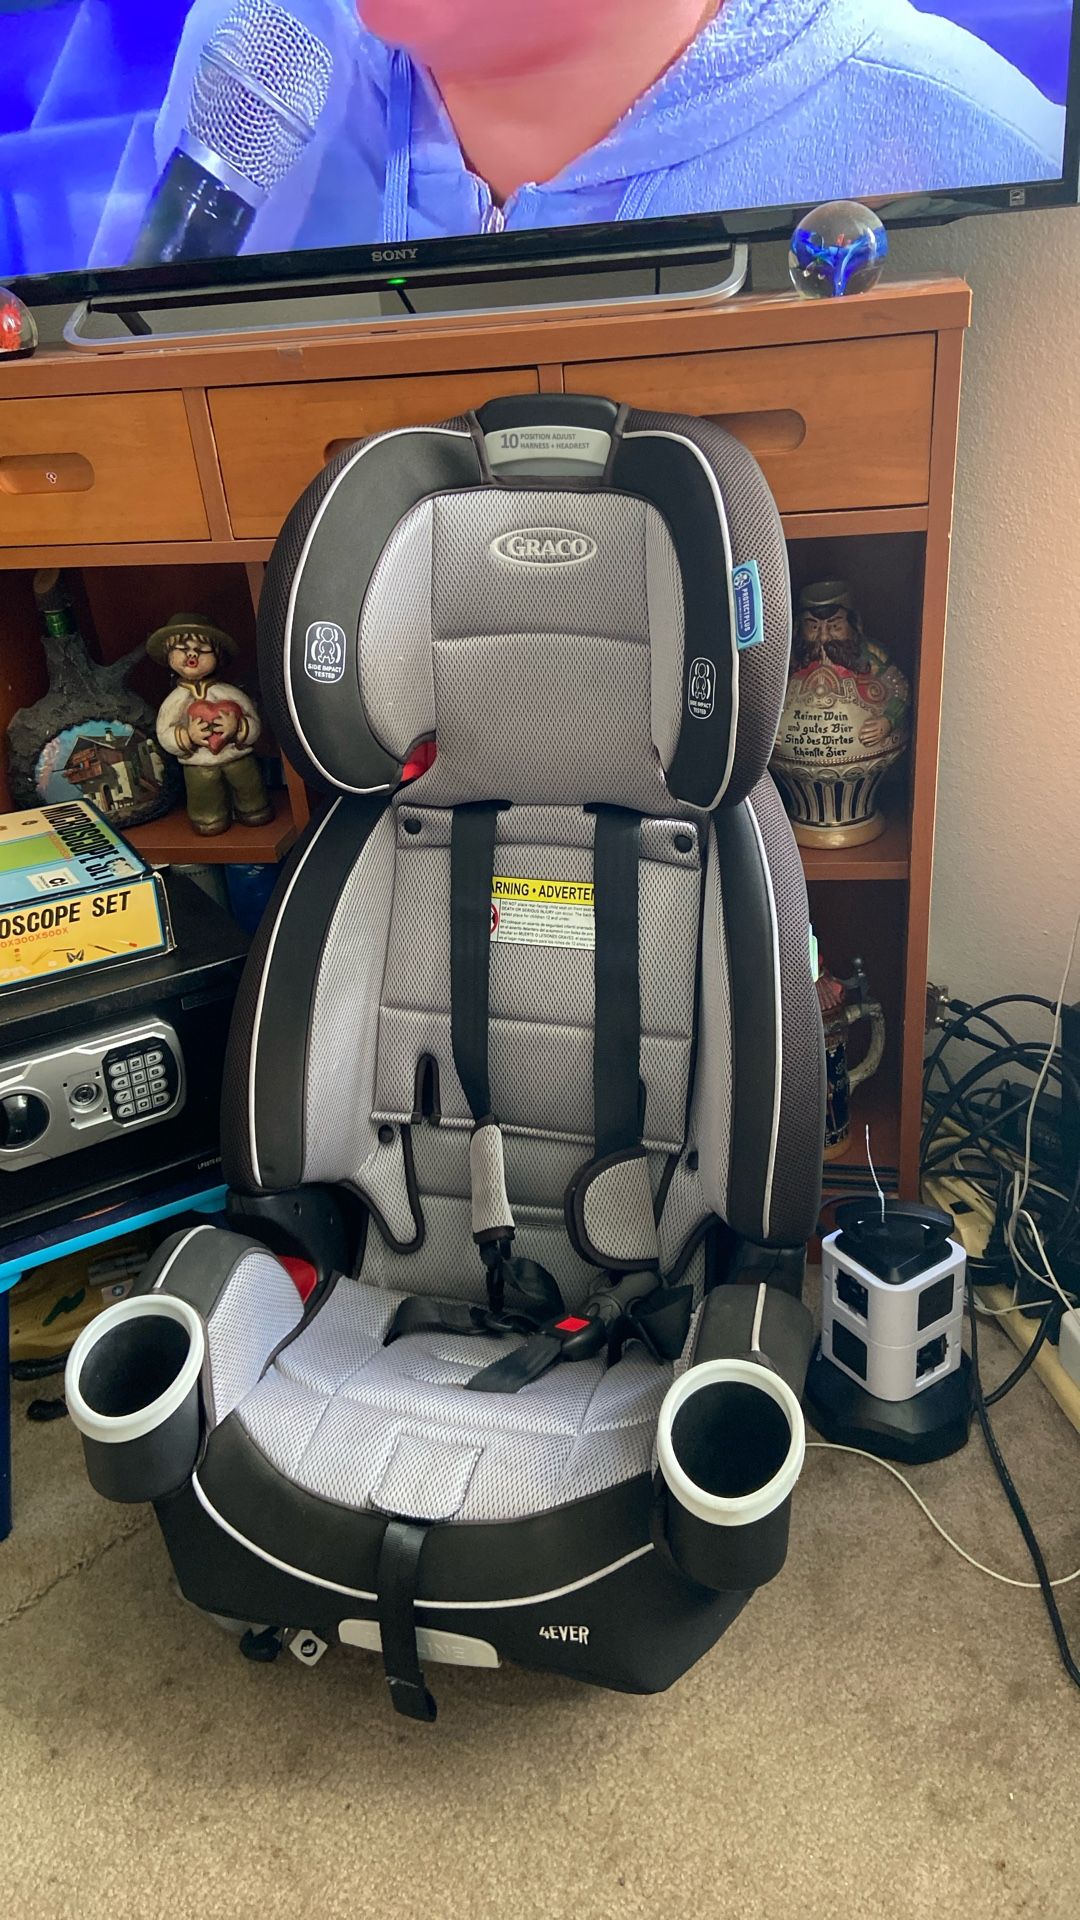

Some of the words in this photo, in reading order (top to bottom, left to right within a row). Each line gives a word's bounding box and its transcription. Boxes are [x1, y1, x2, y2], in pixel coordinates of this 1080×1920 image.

[371, 248, 418, 262] SONY
[500, 433, 519, 449] 10
[506, 536, 588, 556] GRACO
[307, 663, 321, 671] SIDE
[322, 665, 342, 673] IMPACT
[314, 671, 335, 679] TESTED
[793, 710, 822, 721] Reiner
[823, 711, 849, 721] Wein
[788, 722, 800, 732] und
[801, 723, 828, 735] gutes
[831, 723, 853, 733] Bier
[785, 734, 804, 744] Sind
[806, 735, 820, 745] des
[821, 735, 854, 745] Wirtes
[40, 803, 119, 864] MICROSCOPE
[492, 881, 529, 896] RNING
[92, 891, 131, 917] SET
[538, 1625, 590, 1645] 4EVER
